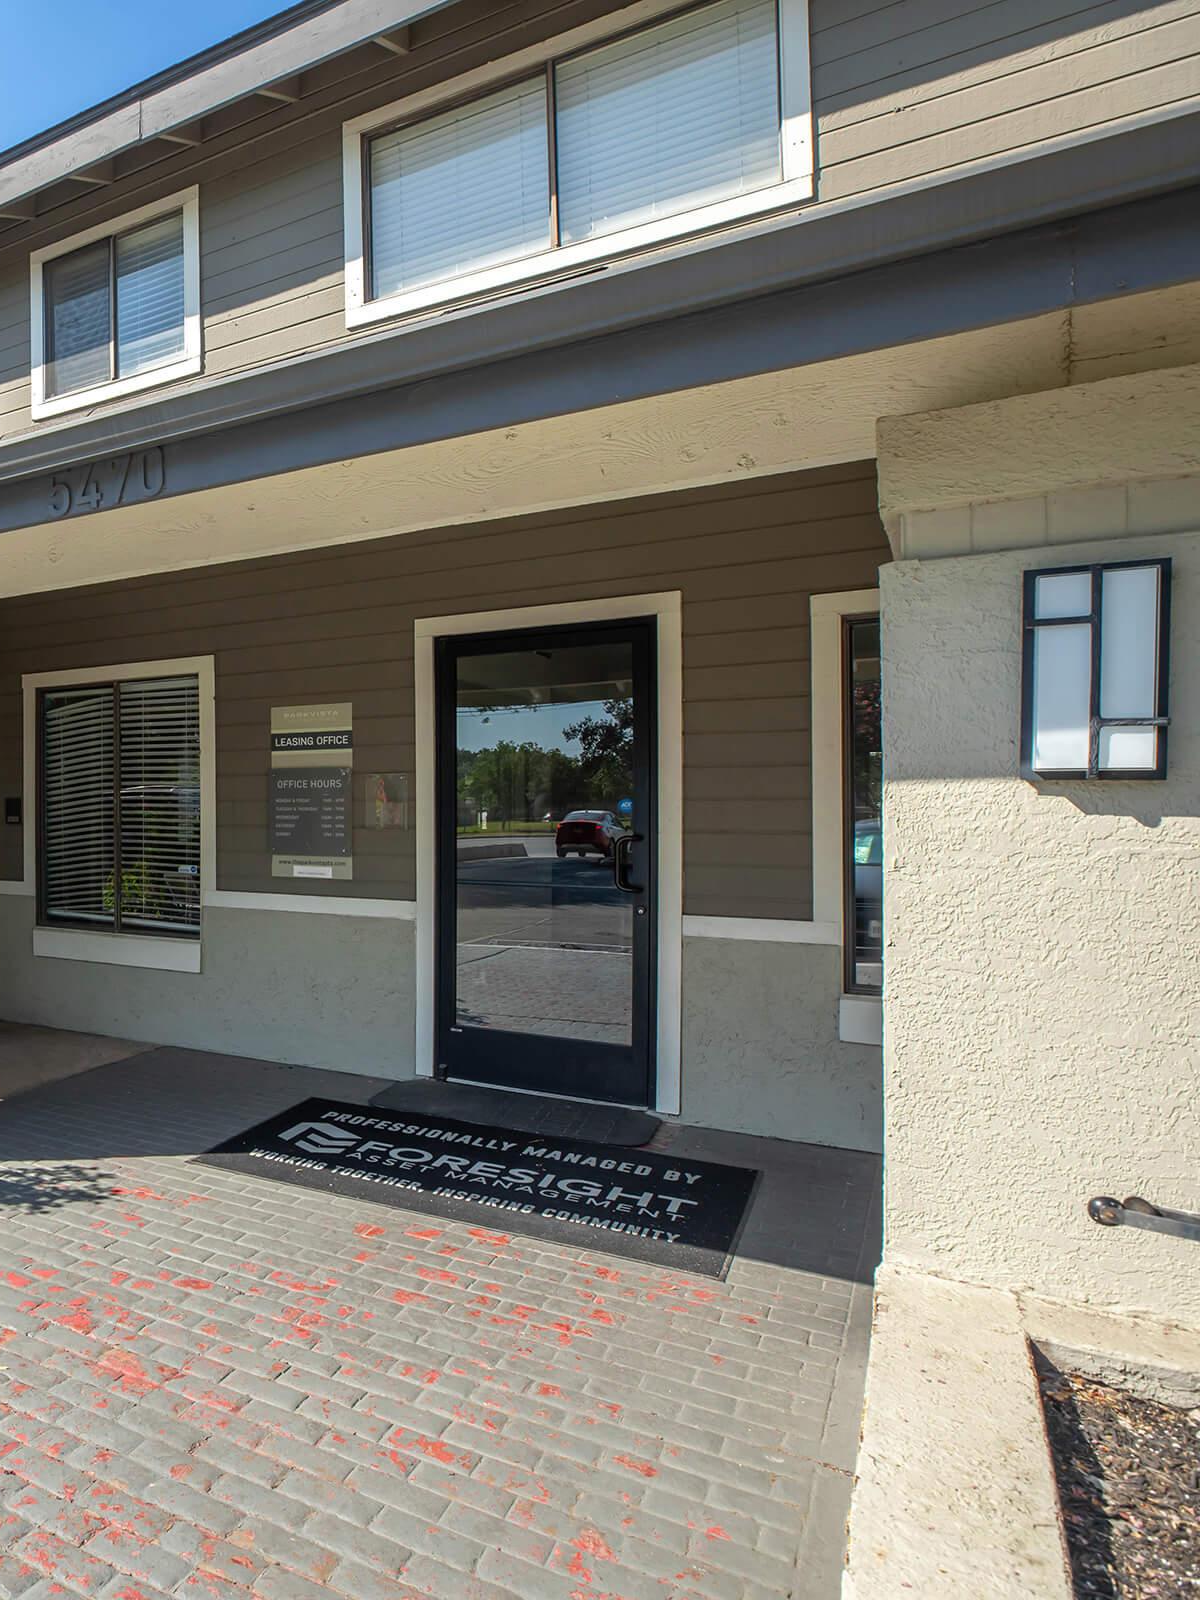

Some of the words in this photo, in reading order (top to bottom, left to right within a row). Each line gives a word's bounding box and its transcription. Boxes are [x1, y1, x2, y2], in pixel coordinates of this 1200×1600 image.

[47, 446, 166, 518] 5470
[274, 736, 314, 747] LEASING
[316, 735, 349, 745] OFFICE
[277, 779, 309, 789] OFFICE
[310, 779, 342, 788] HOURS
[320, 1111, 517, 1151] PROFESSIONALLY
[521, 1146, 653, 1177] MANAGED
[663, 1169, 702, 1185] BY
[354, 1140, 699, 1213] FORESIGHT
[248, 1147, 328, 1171] WORKING
[330, 1165, 425, 1193] TOGETHER,
[433, 1186, 536, 1214] INSPIRING
[541, 1208, 680, 1244] COMMUNITY
[346, 1152, 435, 1174] ASSET
[445, 1171, 685, 1222] MANAGEMENT
